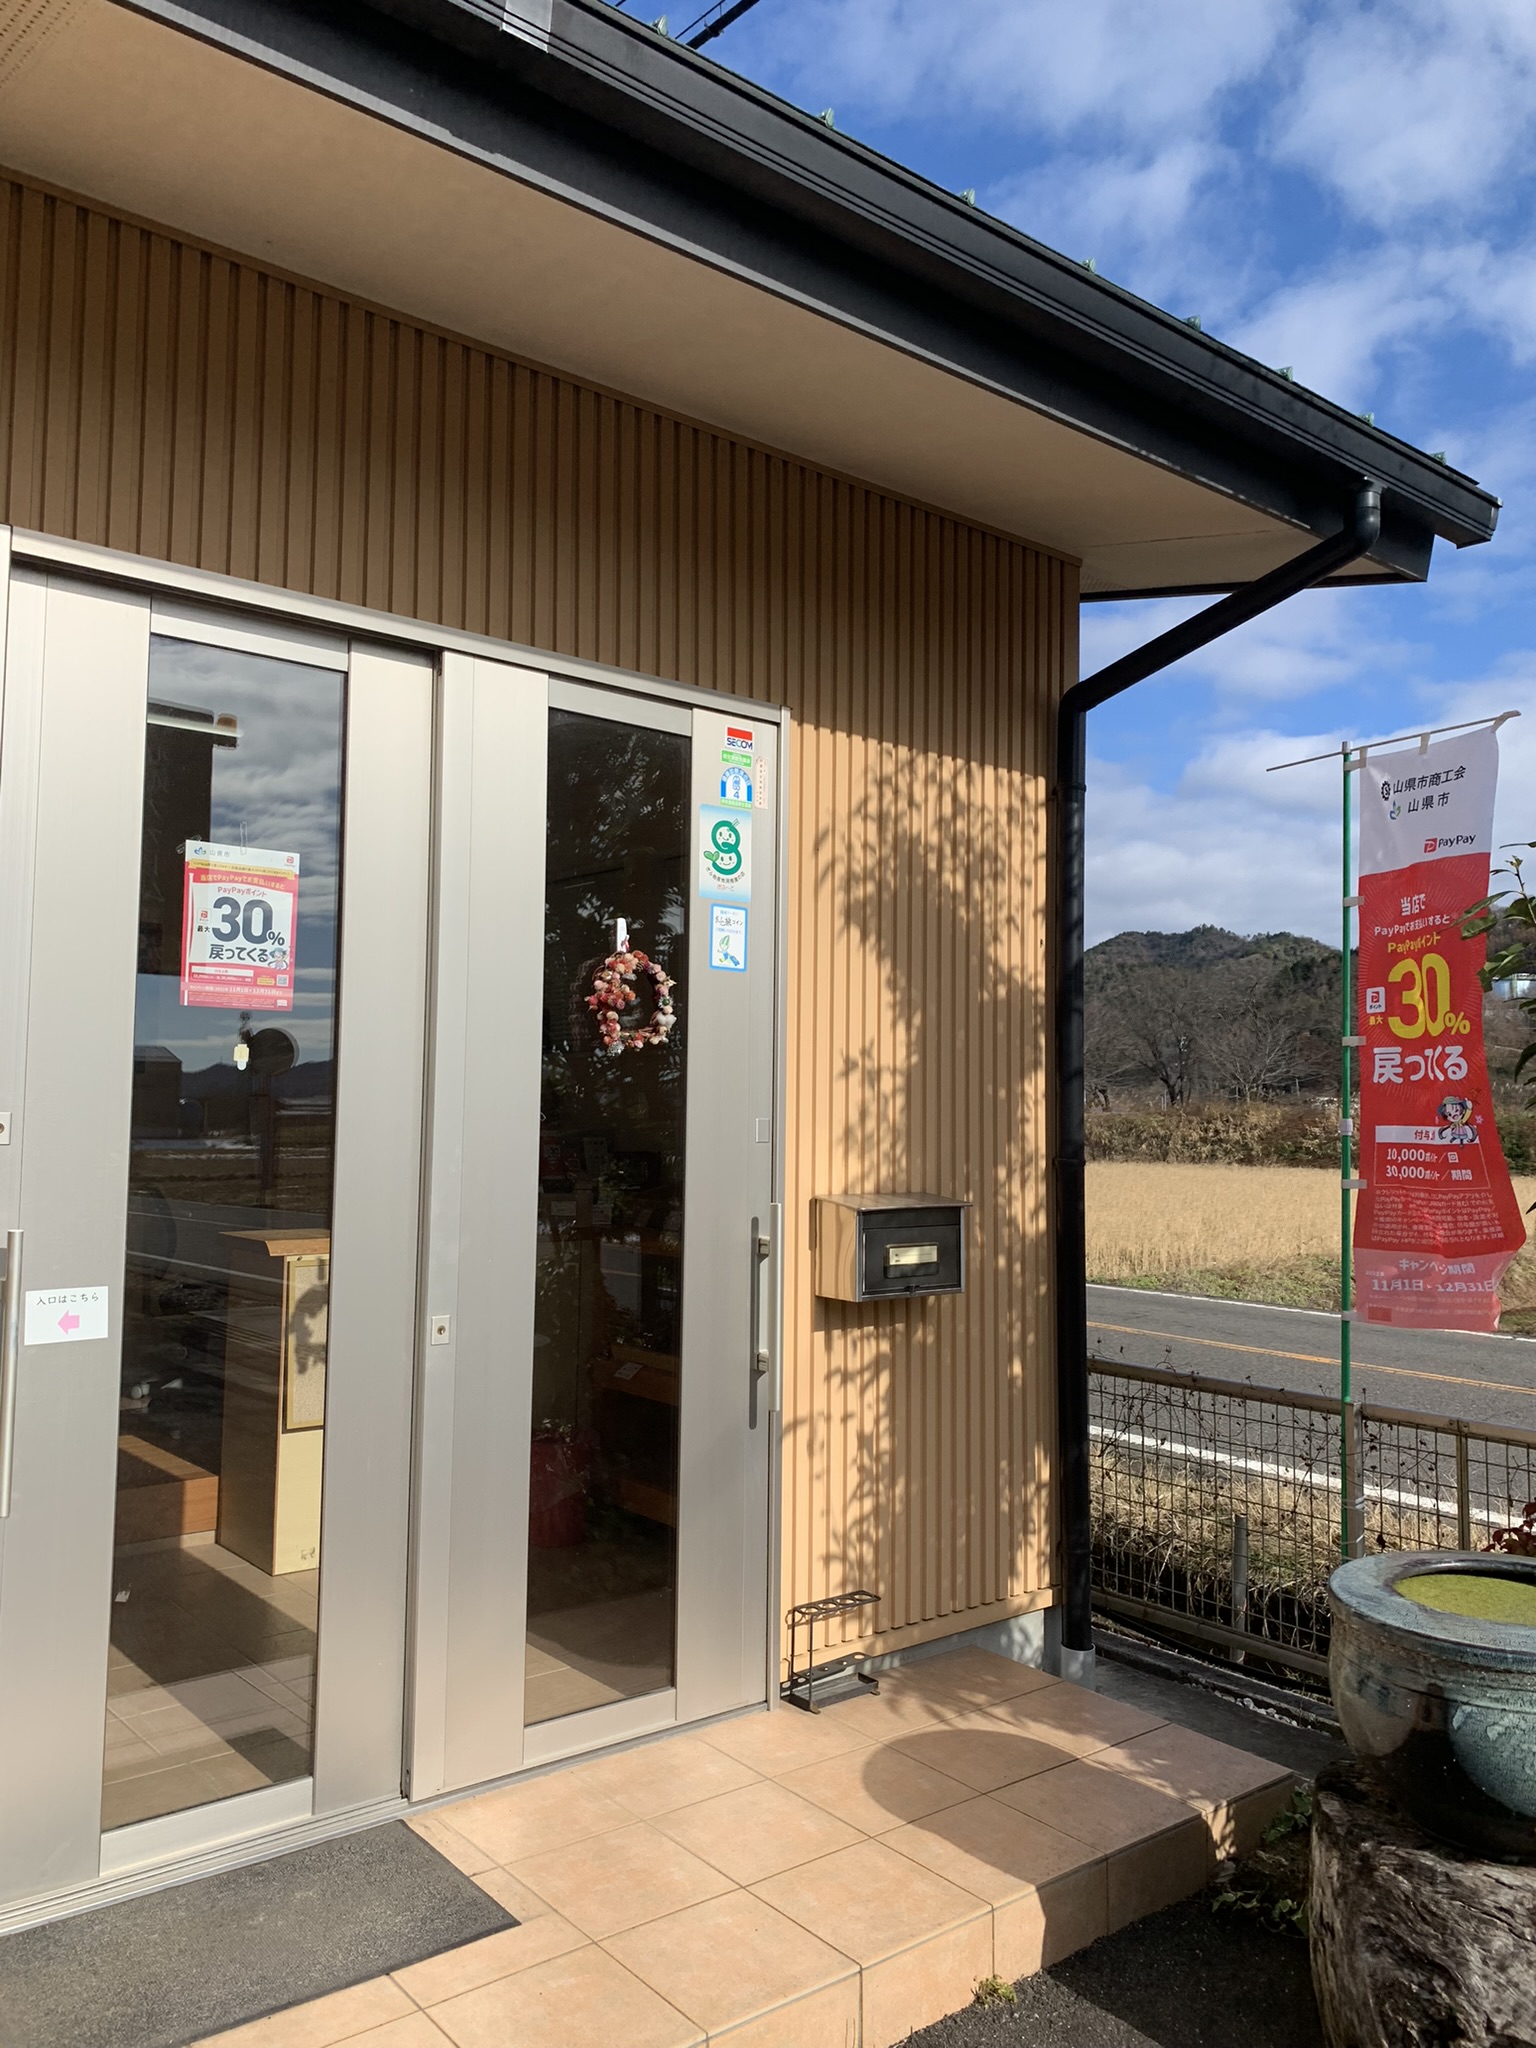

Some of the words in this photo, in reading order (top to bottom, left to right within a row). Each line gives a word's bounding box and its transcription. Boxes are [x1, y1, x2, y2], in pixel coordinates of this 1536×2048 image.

[726, 737, 753, 750] SECOM
[1393, 765, 1467, 794] 山県市商工会
[1407, 792, 1451, 813] 山県市
[1438, 834, 1477, 848] PayPay
[217, 886, 268, 897] PayPayポイント
[1400, 893, 1427, 916] 当店で
[208, 943, 270, 963] 戻ってくる
[36, 1292, 99, 1306] 入口はこちら
